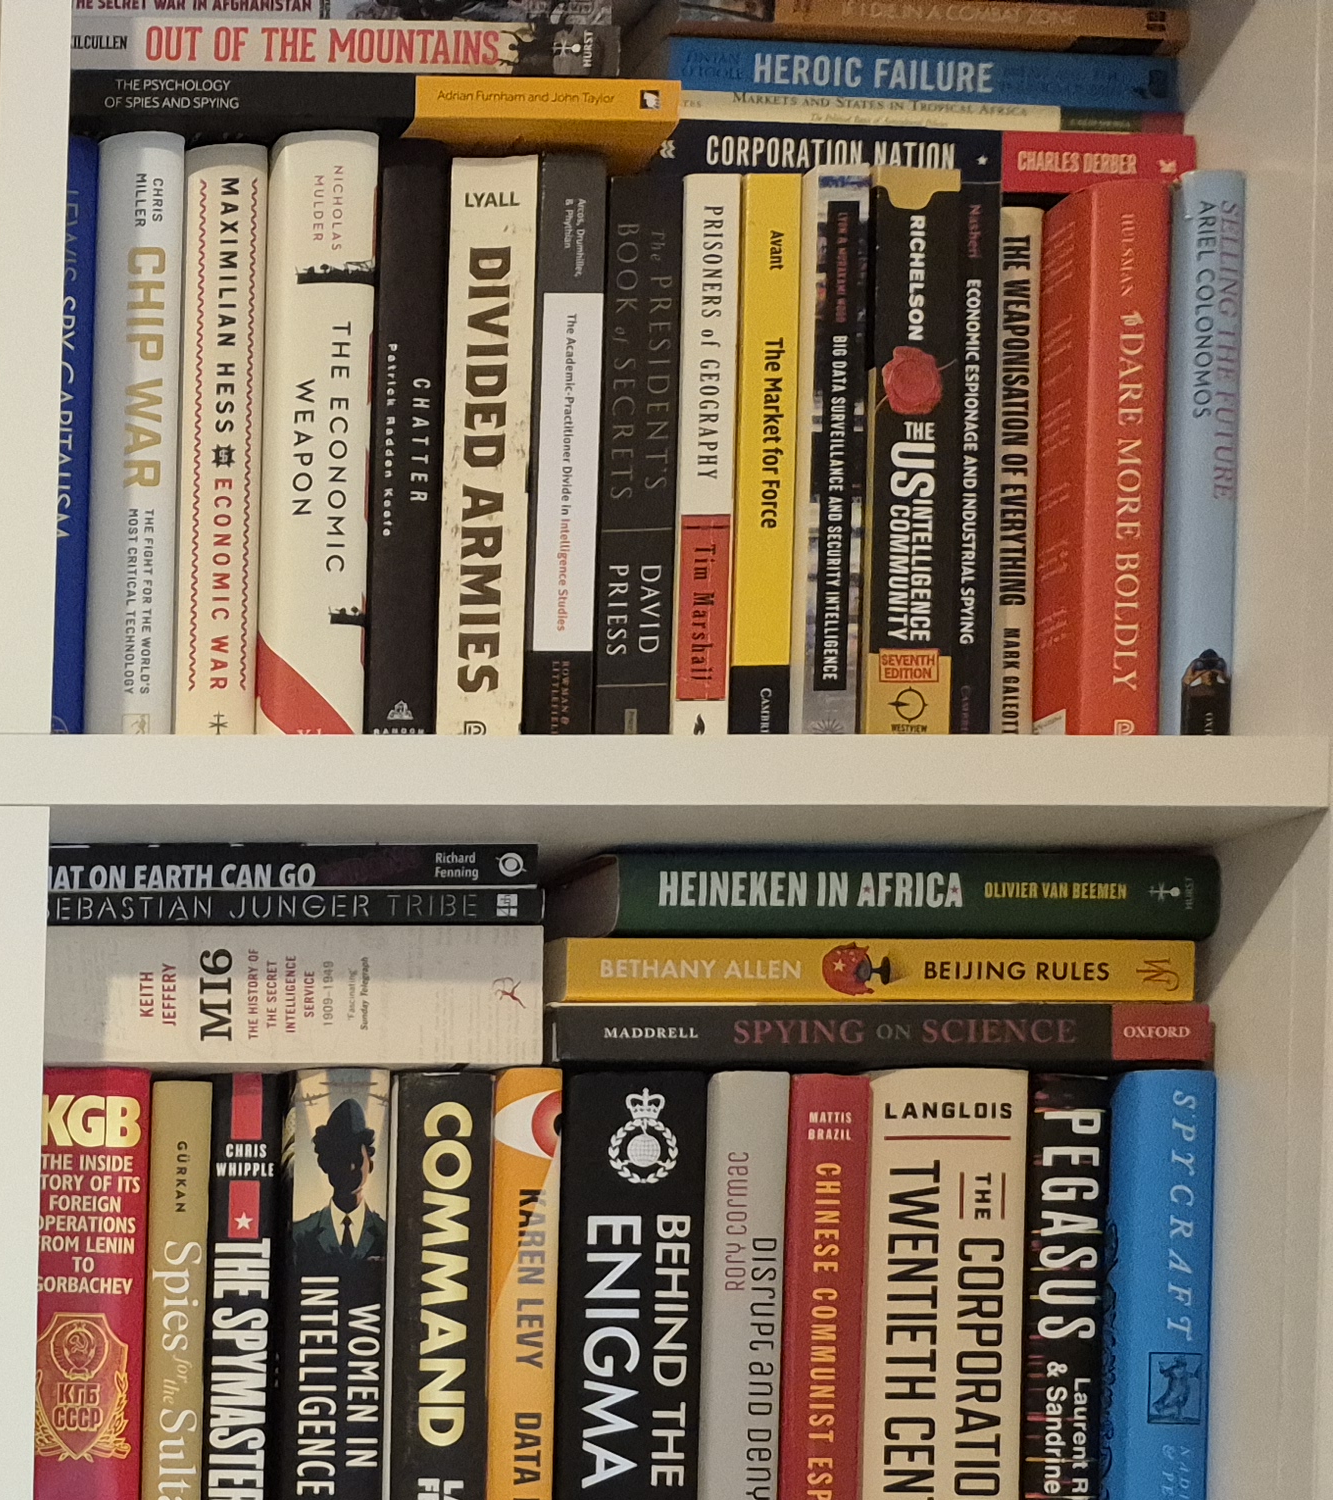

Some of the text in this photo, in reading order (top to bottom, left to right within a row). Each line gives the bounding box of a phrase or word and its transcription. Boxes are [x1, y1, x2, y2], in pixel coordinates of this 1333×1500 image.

[146, 26, 500, 66] OUT OF THE MOUNTAINS
[754, 53, 862, 87] HEROIC
[874, 59, 993, 93] FAILURE
[117, 79, 230, 91] THE PSYCHOLOGY
[104, 96, 239, 109] OF SPIES AND SPYING
[465, 192, 520, 207] LYALL
[606, 565, 629, 655] PRIESS
[639, 565, 661, 653] DAVID
[881, 654, 935, 665] SEVENTH
[885, 668, 932, 679] EDITION
[659, 871, 963, 908] HEINEKEN IN AFRICA
[925, 961, 1109, 981] BEIJING RULES
[200, 949, 232, 1041] MI6
[604, 1027, 698, 1038] MADDRELL
[1123, 1026, 1190, 1038] OXFORD
[885, 1102, 1012, 1119] LANGLOIS
[226, 1144, 266, 1158] CHRIS
[216, 1162, 273, 1177] WHIPPLE
[53, 1407, 101, 1430] СССР
